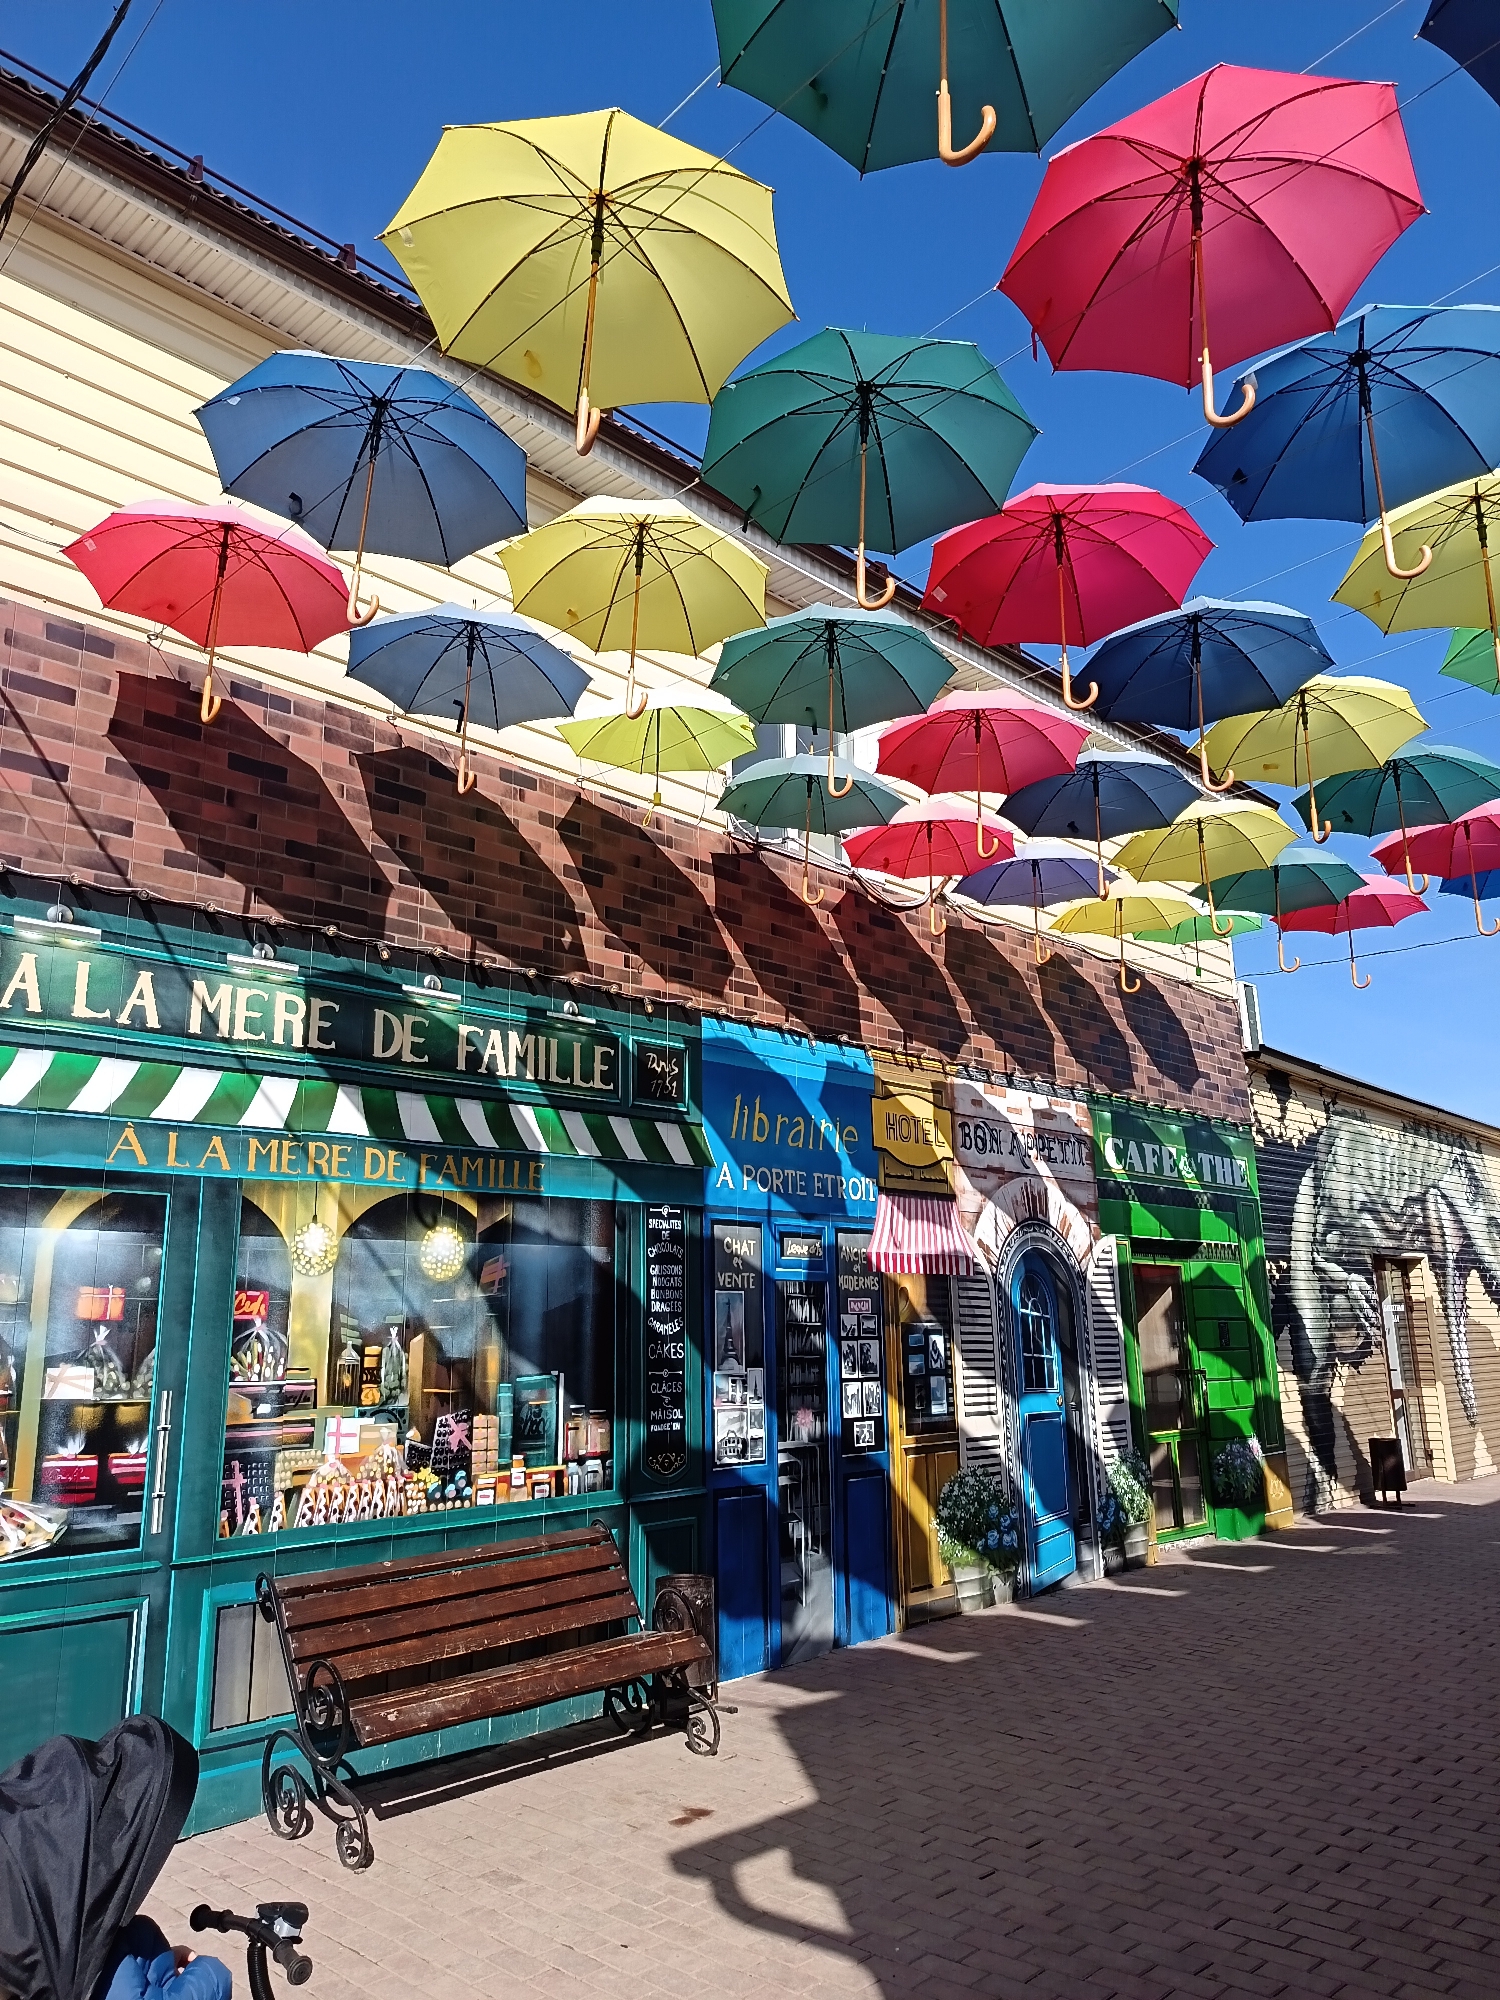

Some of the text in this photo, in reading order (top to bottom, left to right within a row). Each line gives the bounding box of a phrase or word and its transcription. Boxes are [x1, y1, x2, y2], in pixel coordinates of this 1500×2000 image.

[0, 952, 615, 1090] A LA MERE DE FAMILLE
[730, 1093, 859, 1154] librairie
[884, 1111, 946, 1148] HOTEL
[958, 1120, 1004, 1155] BON
[166, 1131, 231, 1171] LA
[247, 1133, 352, 1178] MÈRE
[363, 1146, 407, 1182] DE
[1104, 1136, 1179, 1178] CAFE
[1197, 1152, 1248, 1188] THE
[715, 1161, 877, 1202] A PORTE ETROIT
[661, 1230, 671, 1241] DE
[723, 1236, 756, 1256] CHAT
[650, 1288, 683, 1300] BONBONS
[717, 1271, 756, 1289] VENTE
[838, 1274, 879, 1291] MODERNES
[651, 1300, 683, 1312] DRAGEES
